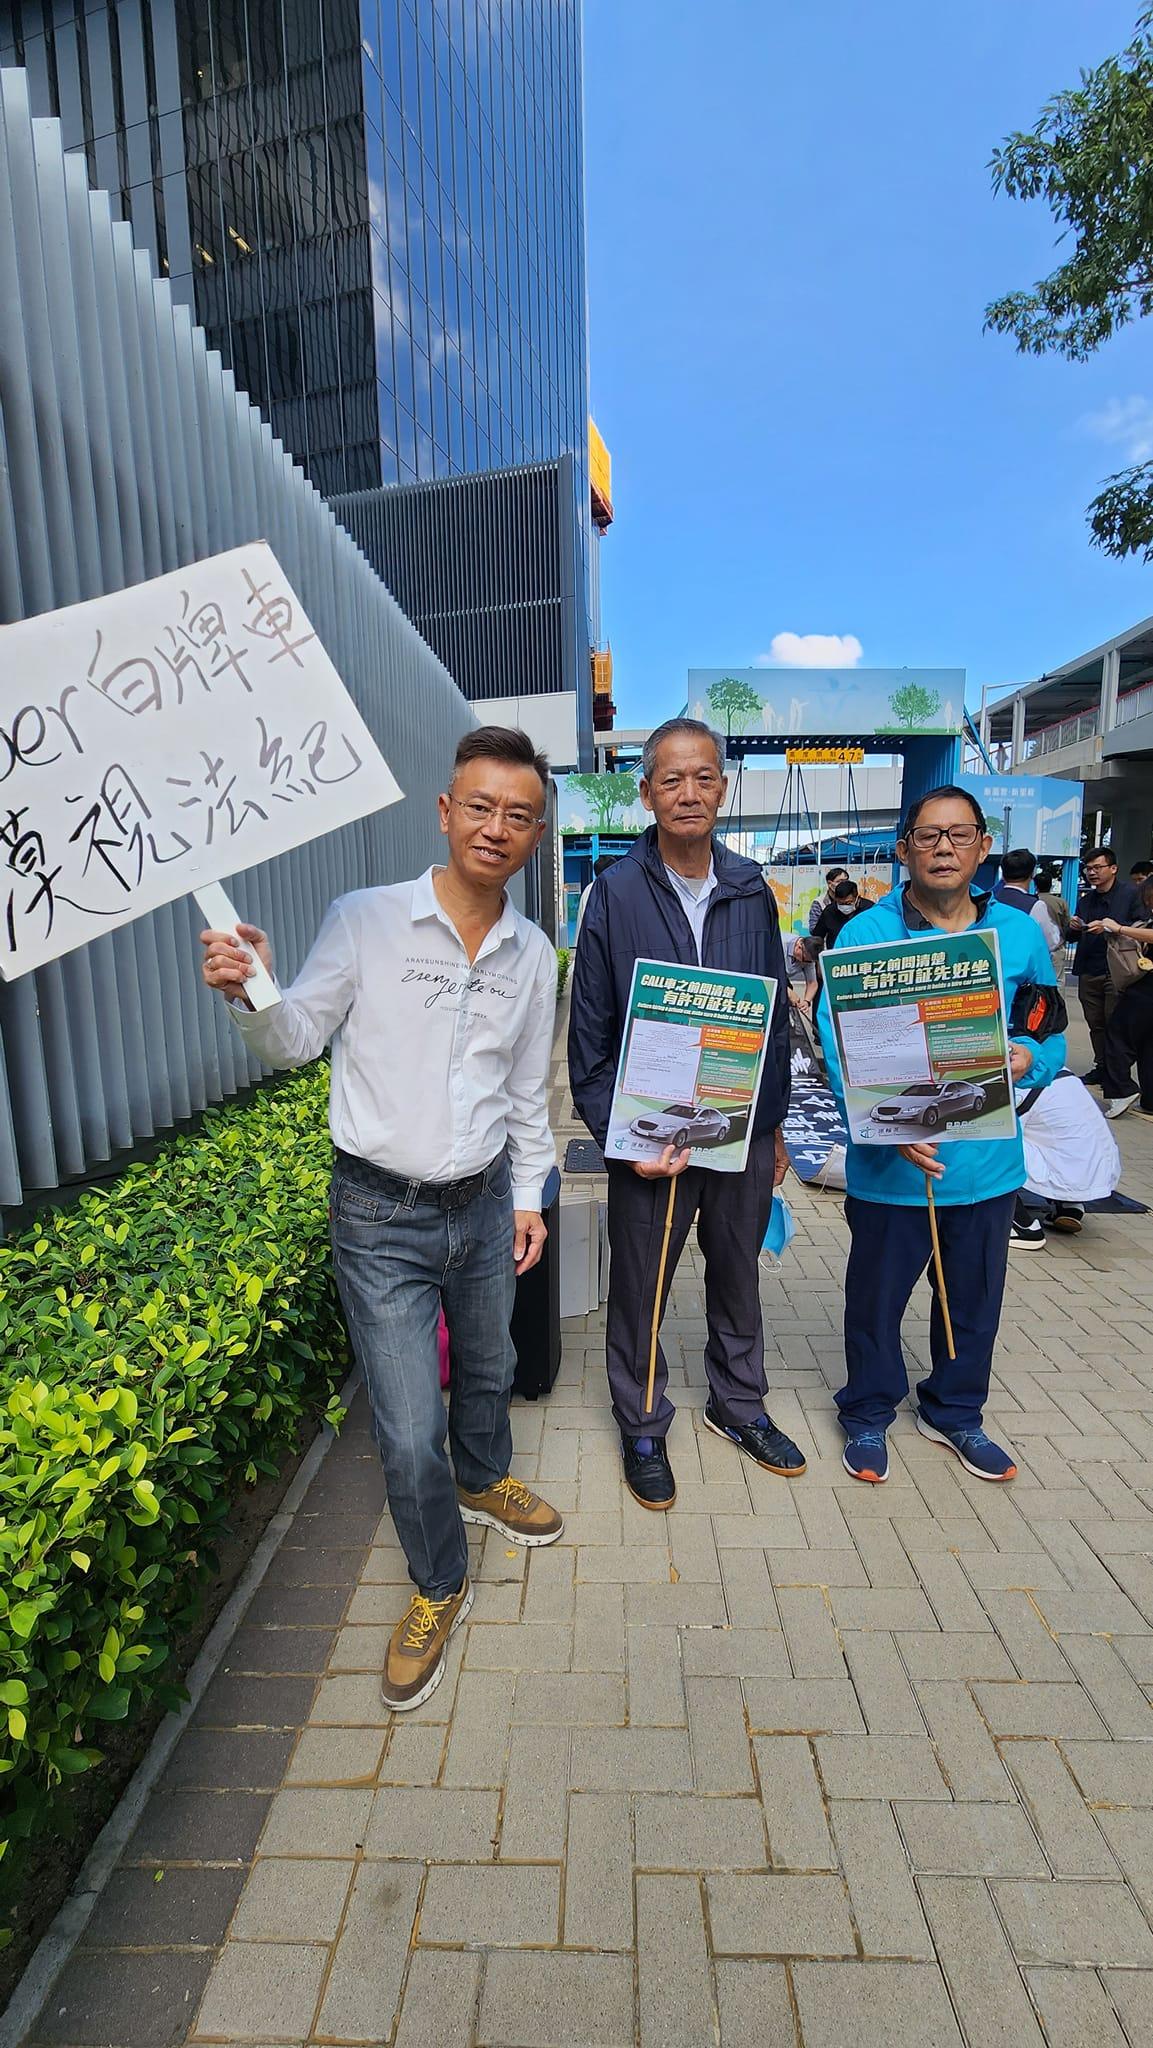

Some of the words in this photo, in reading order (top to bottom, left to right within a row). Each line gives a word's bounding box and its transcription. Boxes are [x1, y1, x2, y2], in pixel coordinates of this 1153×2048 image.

[838, 751, 855, 762] 4.7
[831, 951, 946, 979] CALL車之前問清楚
[862, 959, 990, 991] 有許可証先好坐
[640, 974, 737, 999] CALL車之前問清楚
[900, 986, 915, 994] make
[972, 976, 991, 985] permit
[662, 990, 766, 1018] 有許可証先好坐
